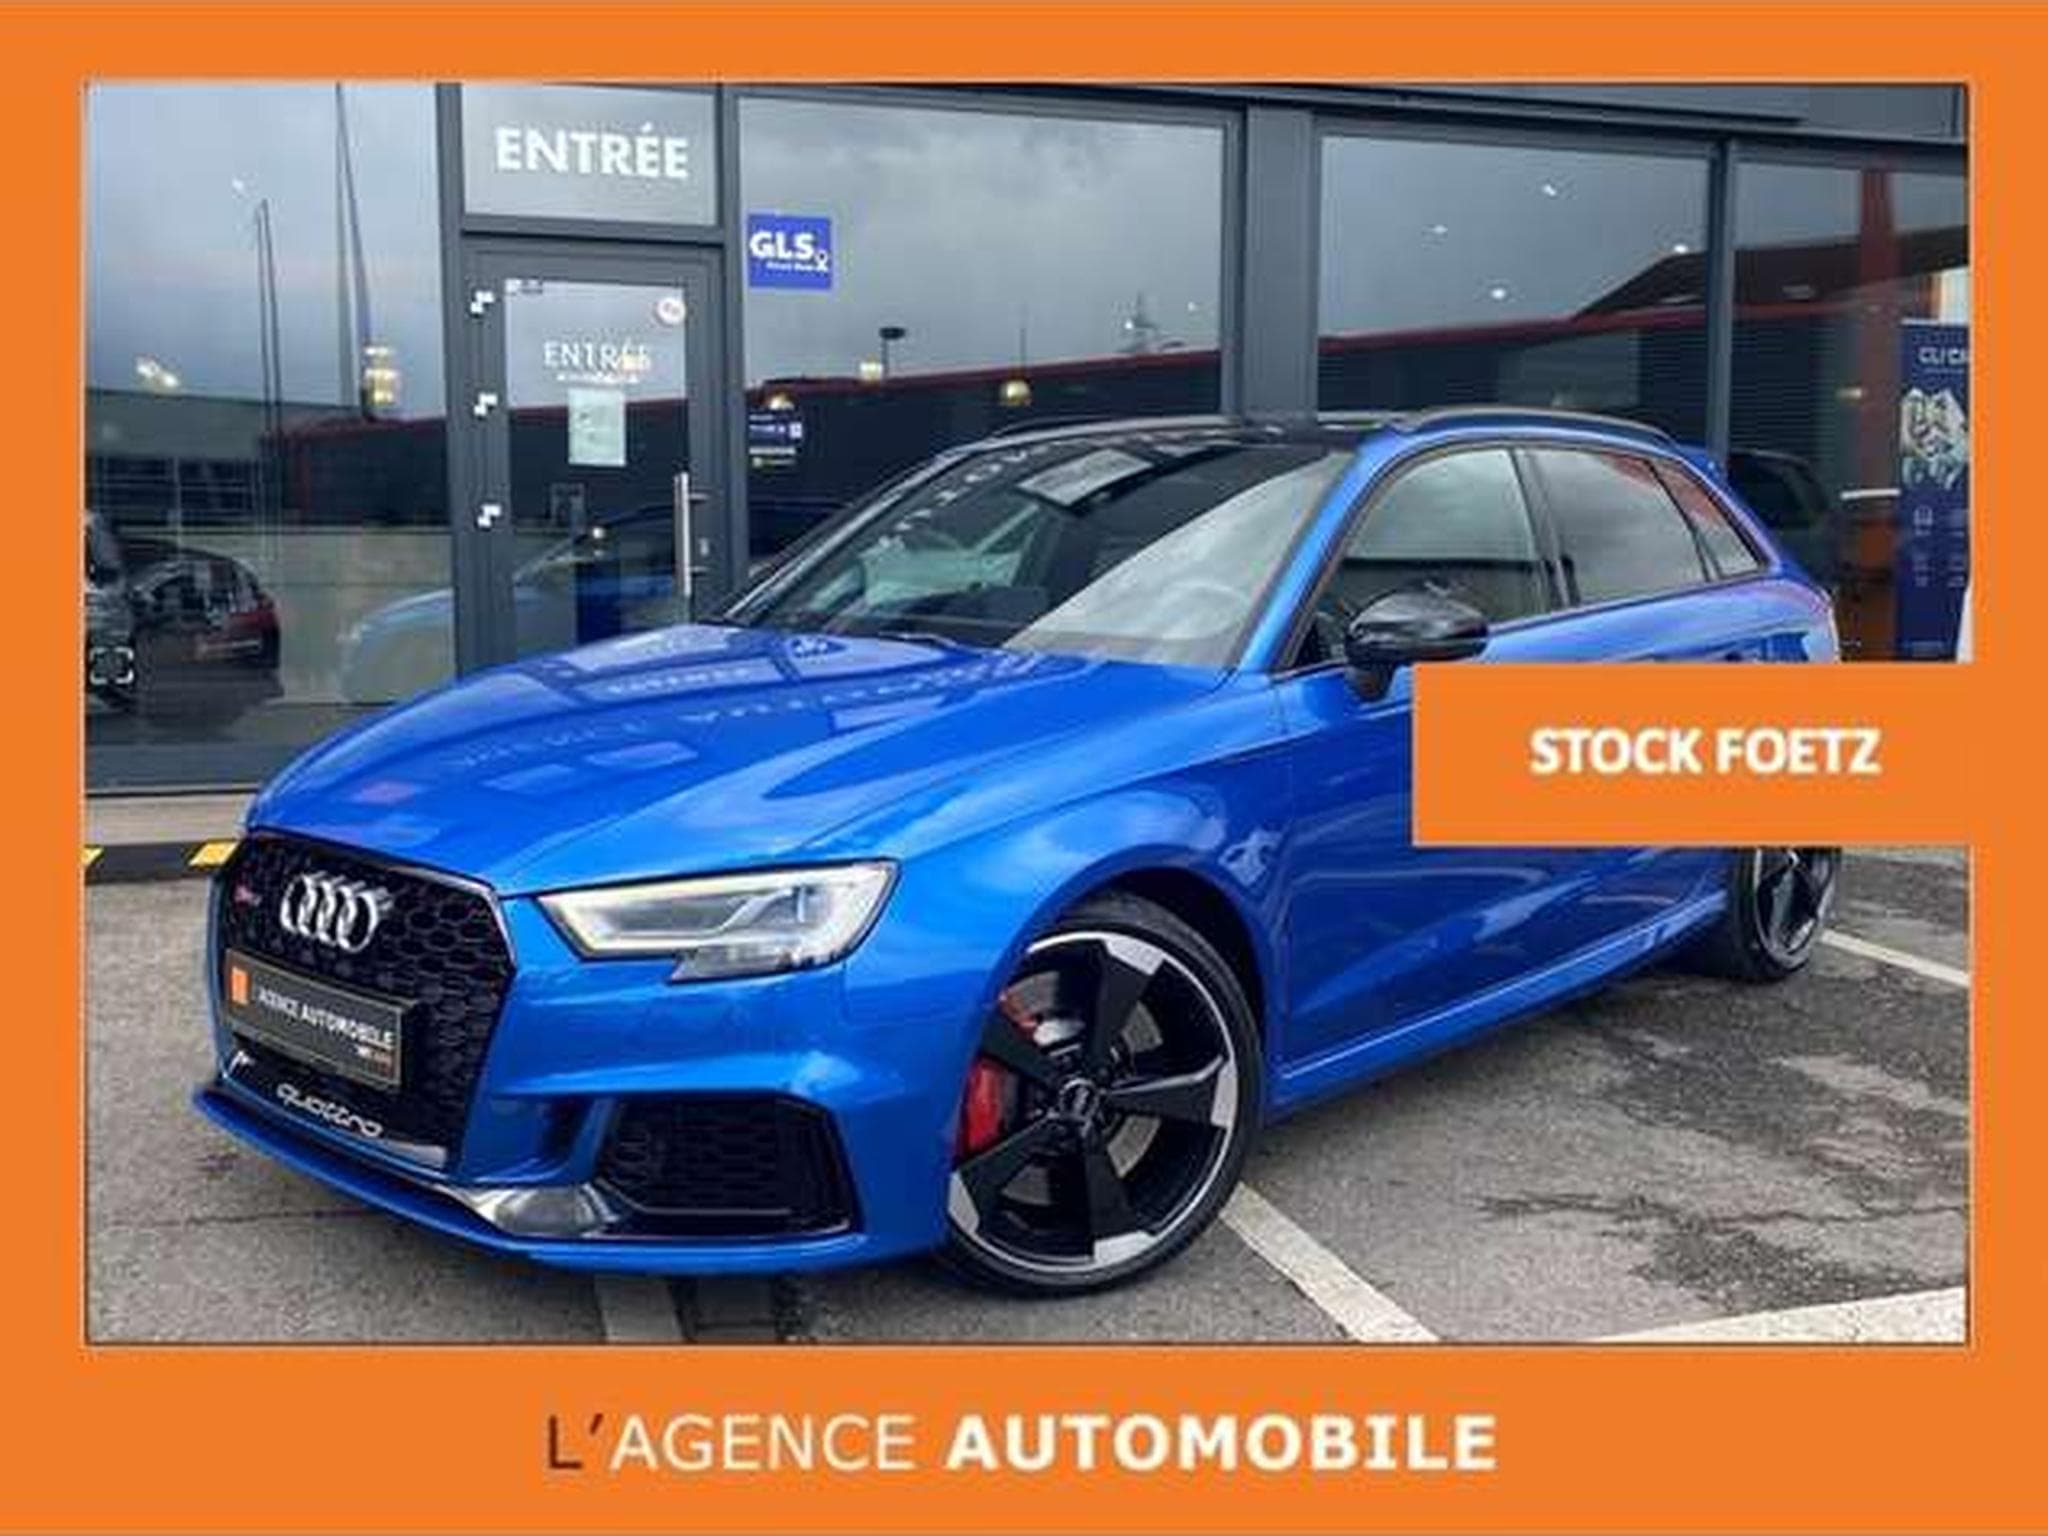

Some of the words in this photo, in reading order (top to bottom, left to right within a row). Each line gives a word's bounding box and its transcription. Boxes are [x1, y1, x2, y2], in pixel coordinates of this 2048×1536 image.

[496, 121, 689, 179] ENTRÉE
[749, 230, 814, 259] GLS
[276, 1082, 384, 1138] quattro
